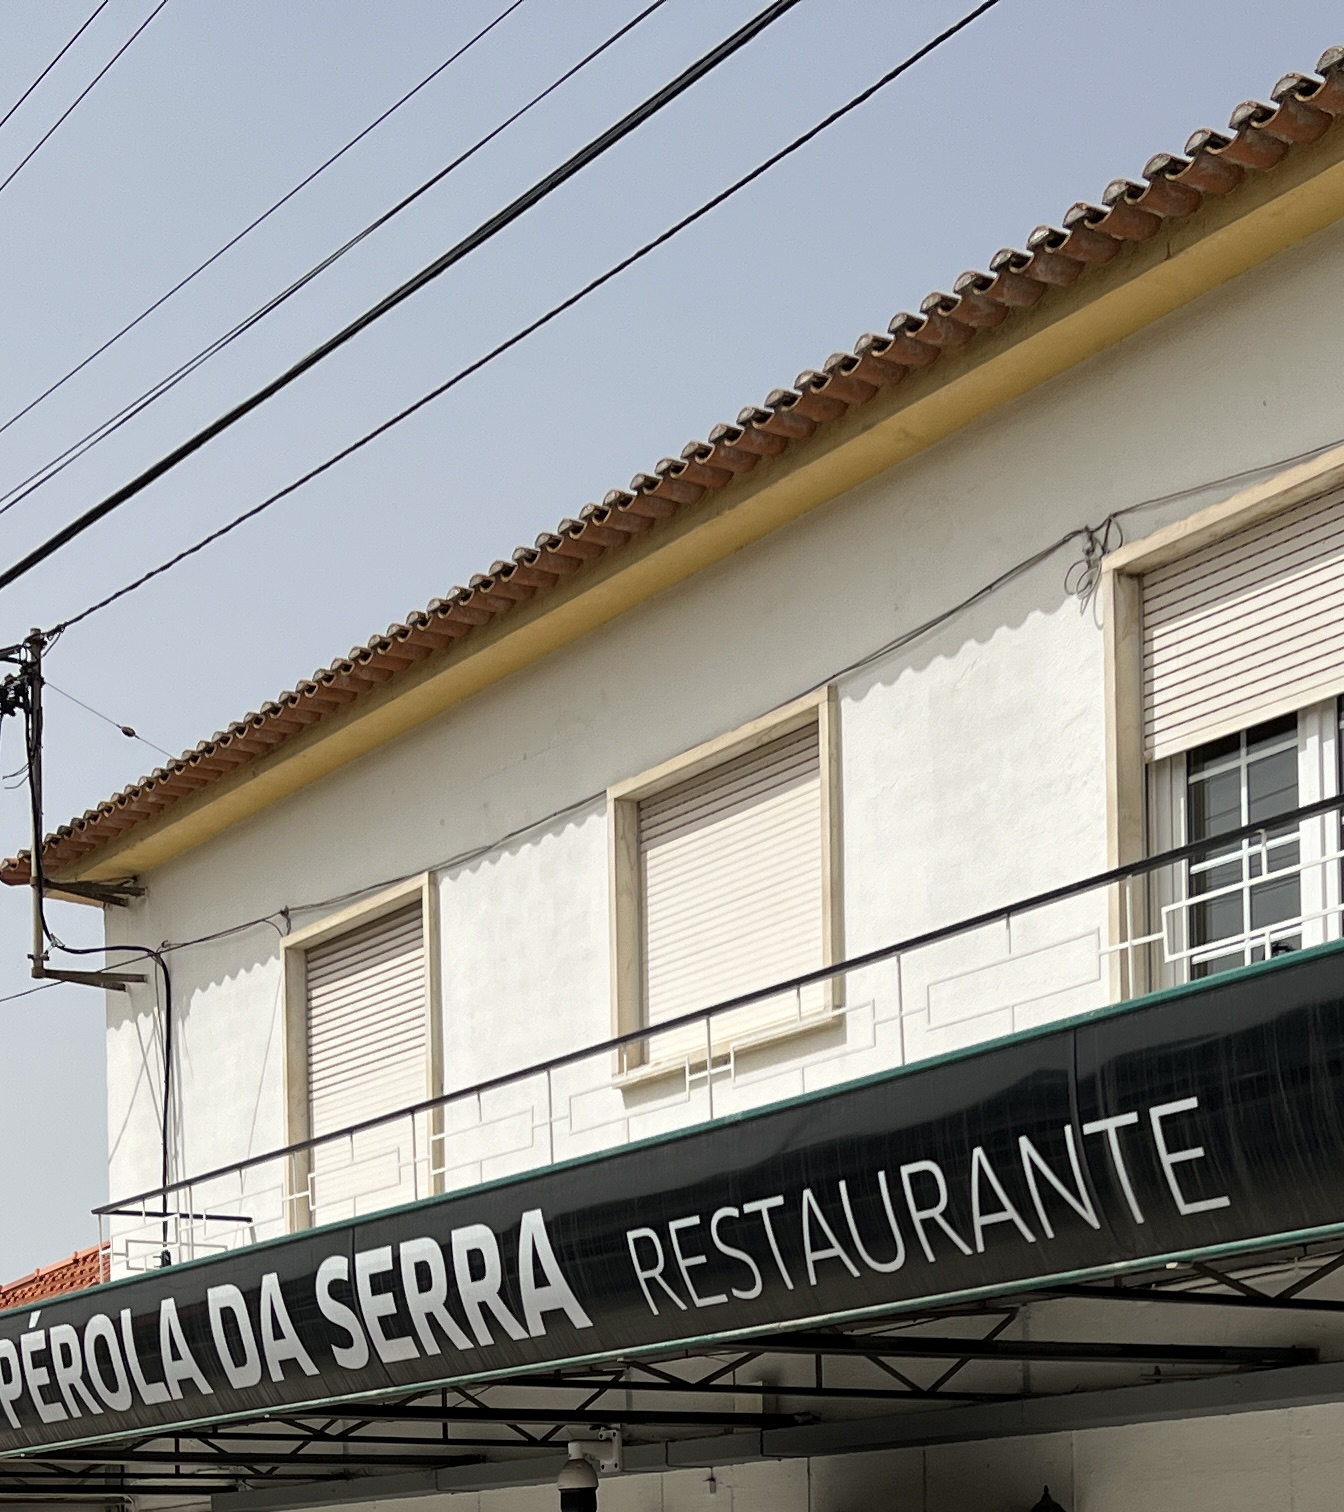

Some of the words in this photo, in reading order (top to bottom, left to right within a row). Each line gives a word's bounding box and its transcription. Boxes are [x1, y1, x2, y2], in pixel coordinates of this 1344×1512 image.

[207, 1272, 321, 1390] DA
[315, 1208, 594, 1371] SERRA
[626, 1096, 1231, 1316] RESTAURANTE
